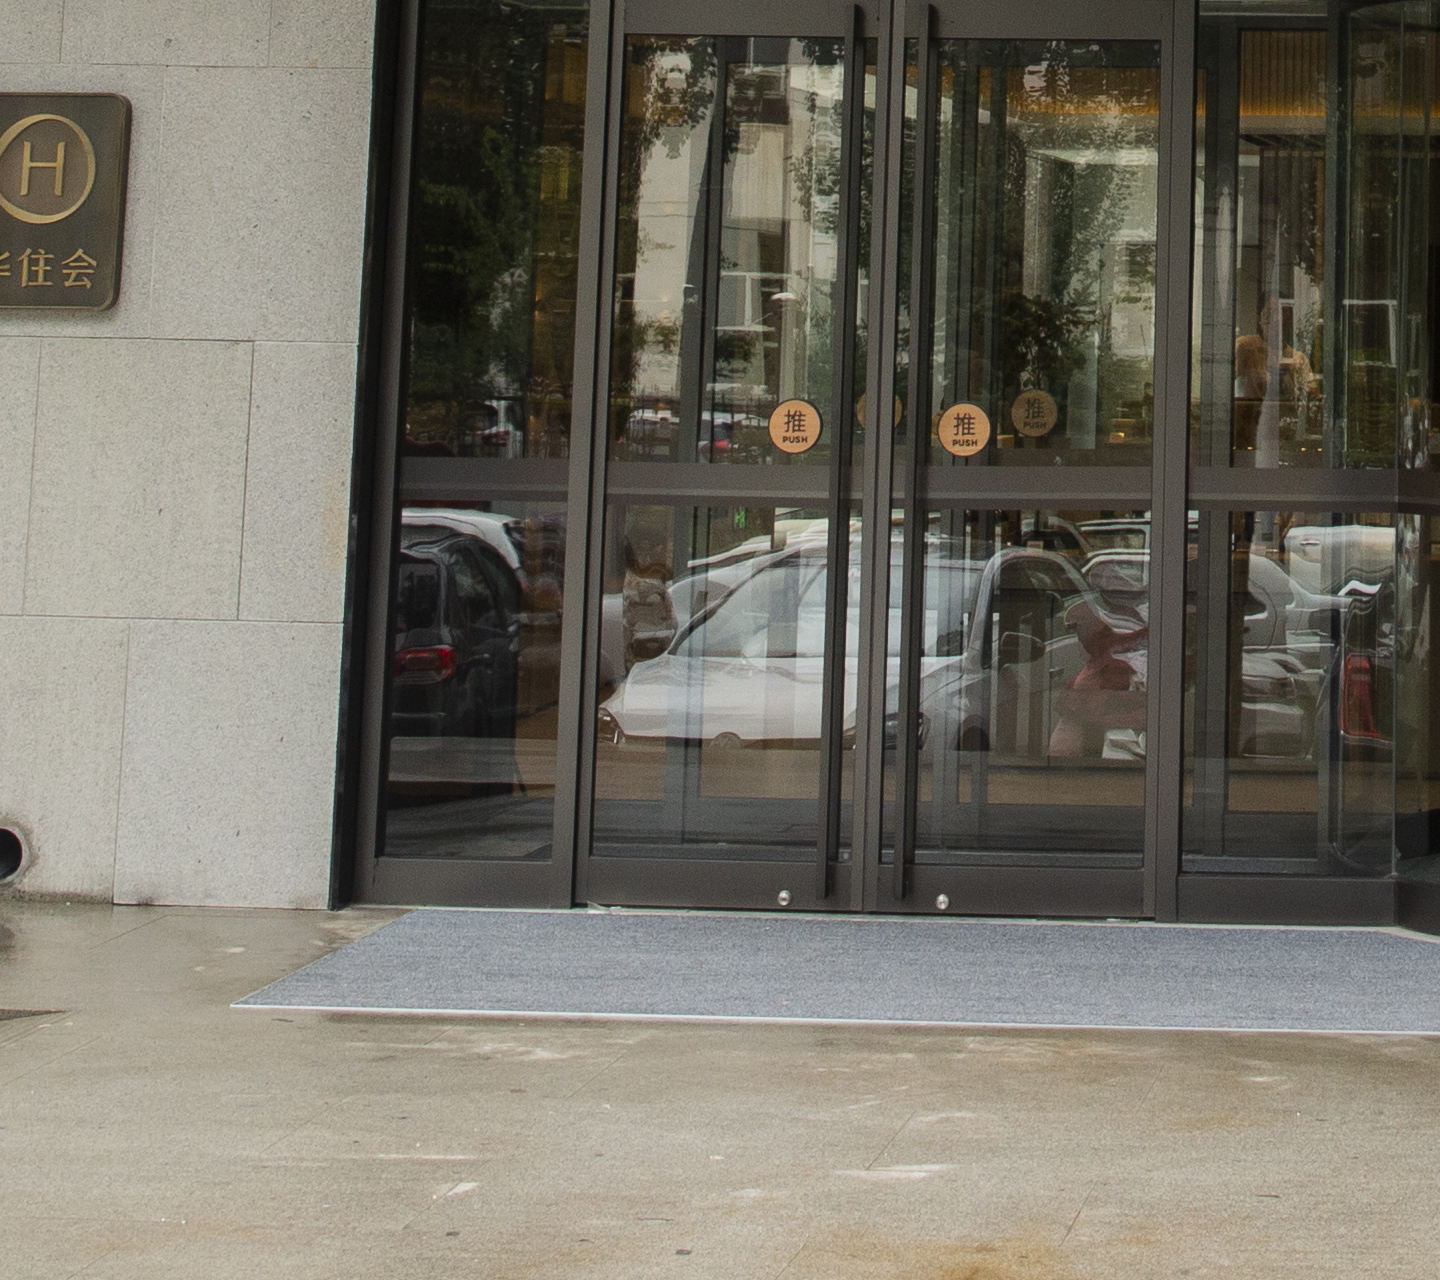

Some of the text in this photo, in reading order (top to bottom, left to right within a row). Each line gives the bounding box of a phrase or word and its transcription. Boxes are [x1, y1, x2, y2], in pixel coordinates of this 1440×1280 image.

[784, 409, 806, 433] 推
[954, 412, 976, 436] 推
[782, 435, 808, 444] PUSH
[952, 438, 978, 447] PUSH
